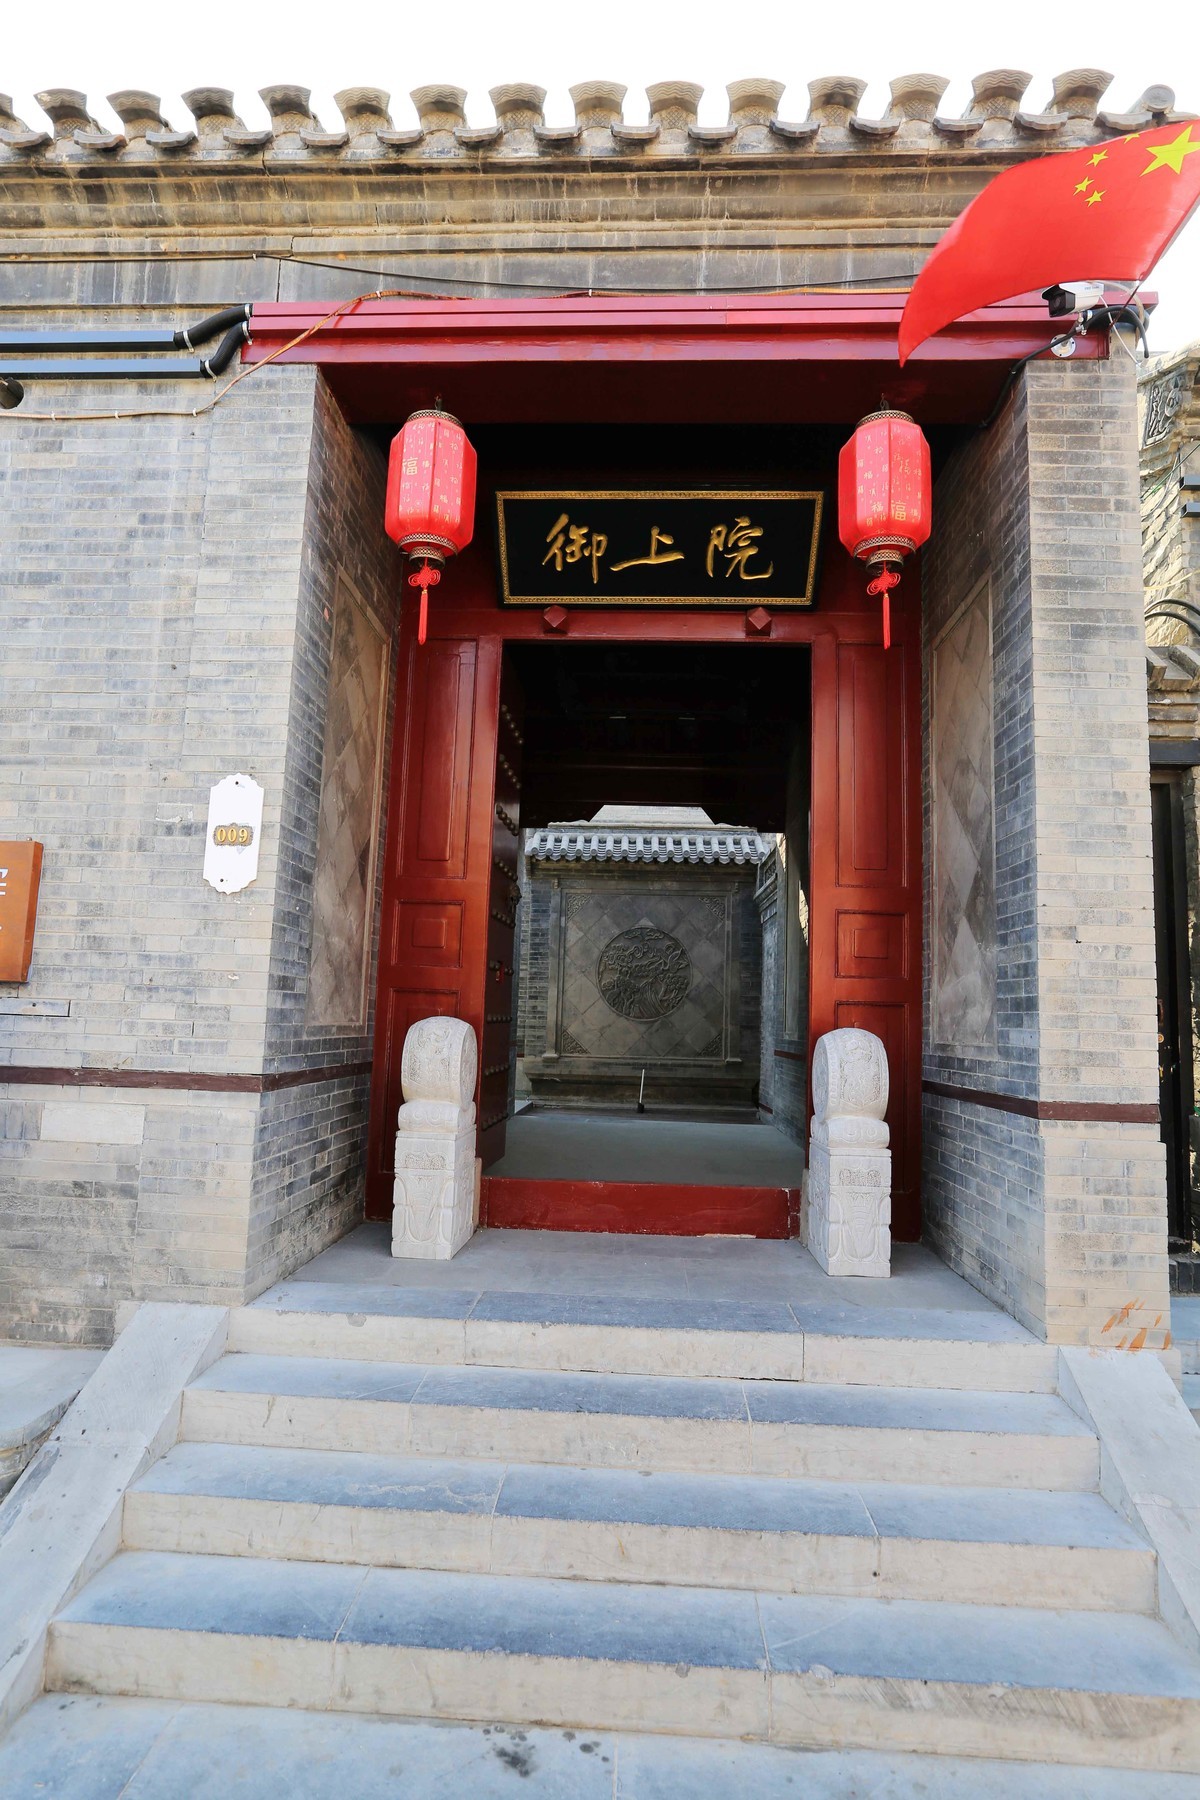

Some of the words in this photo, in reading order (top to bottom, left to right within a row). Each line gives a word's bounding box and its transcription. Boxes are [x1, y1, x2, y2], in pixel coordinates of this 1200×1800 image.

[541, 513, 774, 584] 御上院
[217, 828, 248, 843] 009
